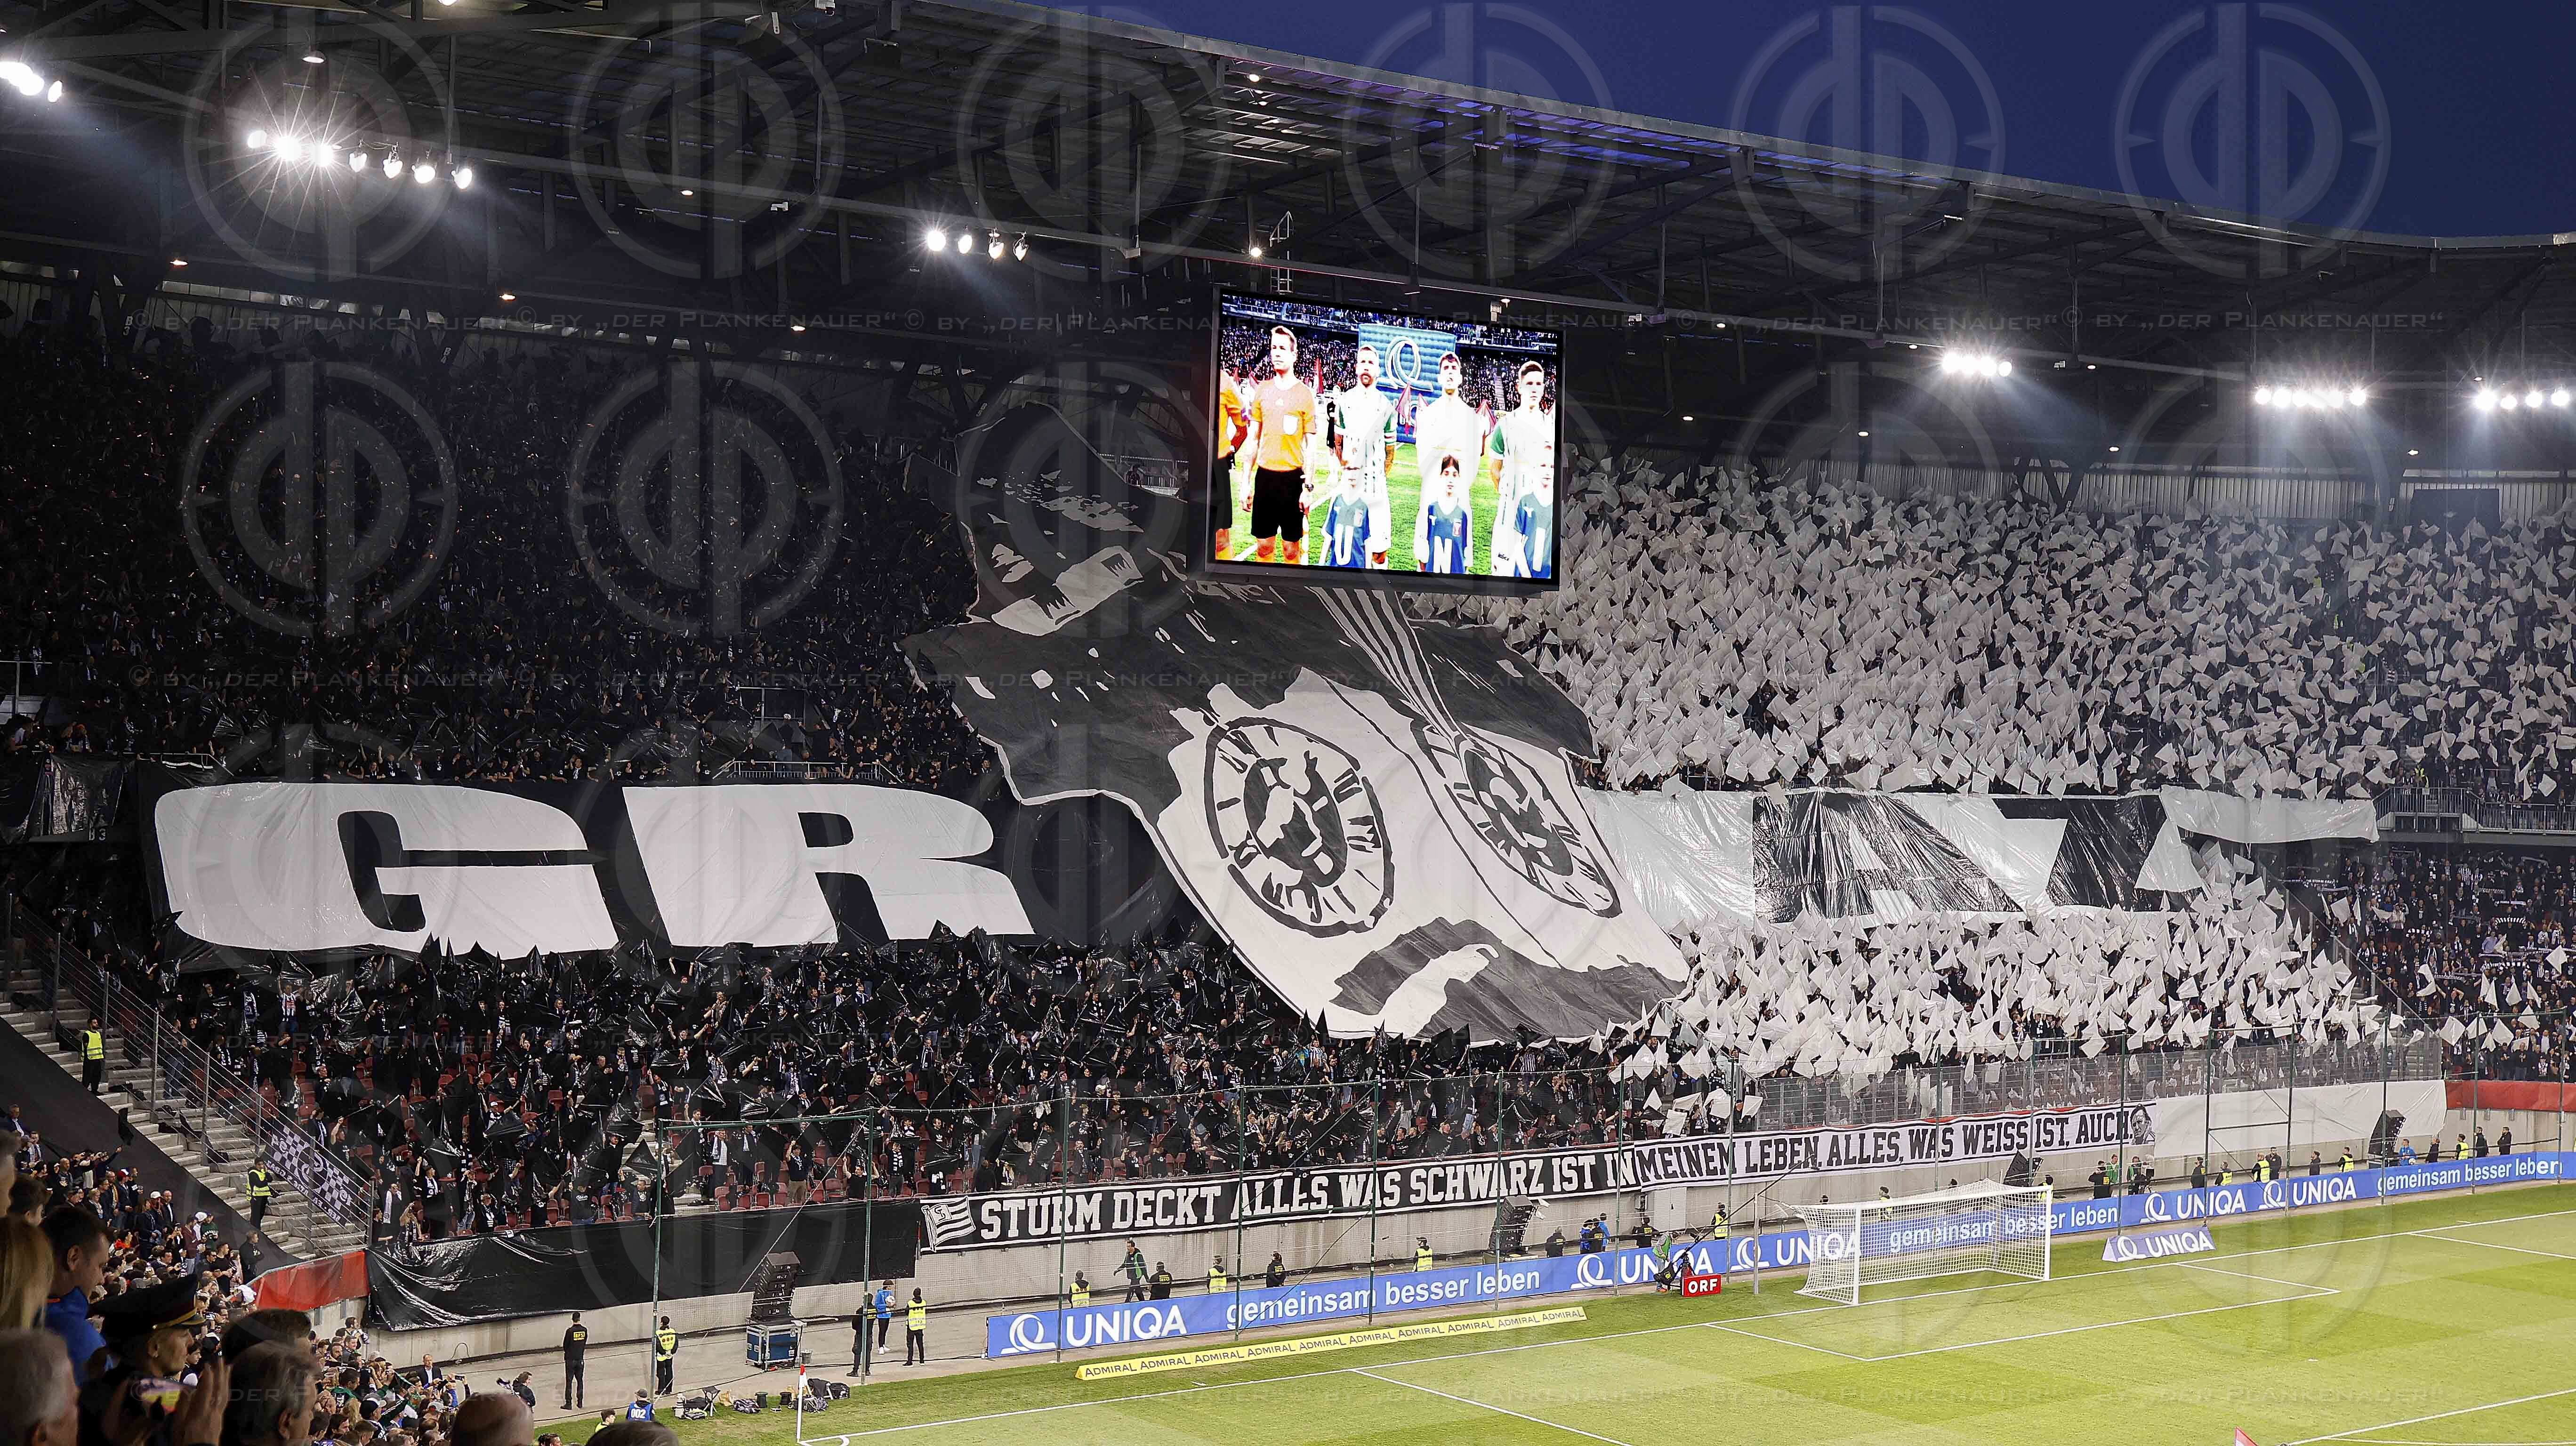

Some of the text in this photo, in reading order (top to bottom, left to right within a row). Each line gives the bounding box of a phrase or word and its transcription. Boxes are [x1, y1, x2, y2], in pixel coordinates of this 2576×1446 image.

[980, 1192, 1102, 1239] STURM
[1112, 1186, 1222, 1229] DECKT
[1339, 1168, 1402, 1209] WAS
[1409, 1158, 1545, 1202] SCHWARZ
[1552, 1153, 1596, 1191] IST
[1607, 1148, 1636, 1185] IN
[1908, 1125, 1954, 1160] WAS
[1962, 1120, 2030, 1154] WEISS
[2292, 1176, 2357, 1206] UNIQA
[2377, 1165, 2461, 1197] gemeinsam
[2464, 1160, 2513, 1182] besser
[2070, 1205, 2118, 1225] leben
[2176, 1189, 2247, 1219] UNIQA
[2145, 1232, 2214, 1257] UNIQA
[1226, 1269, 1540, 1330] gemeinsam besser leben
[1687, 1277, 1721, 1297] ORF
[1067, 1304, 1187, 1347] UNIQA
[1085, 1309, 1585, 1378] ADMIRAL ADMIRAL ADMIRAL ADMIRAL ADMIRAL ADMIRAL ADMIRAL ADMIRAL ADMIRAL ADMIRAL
[631, 1409, 647, 1419] 002
